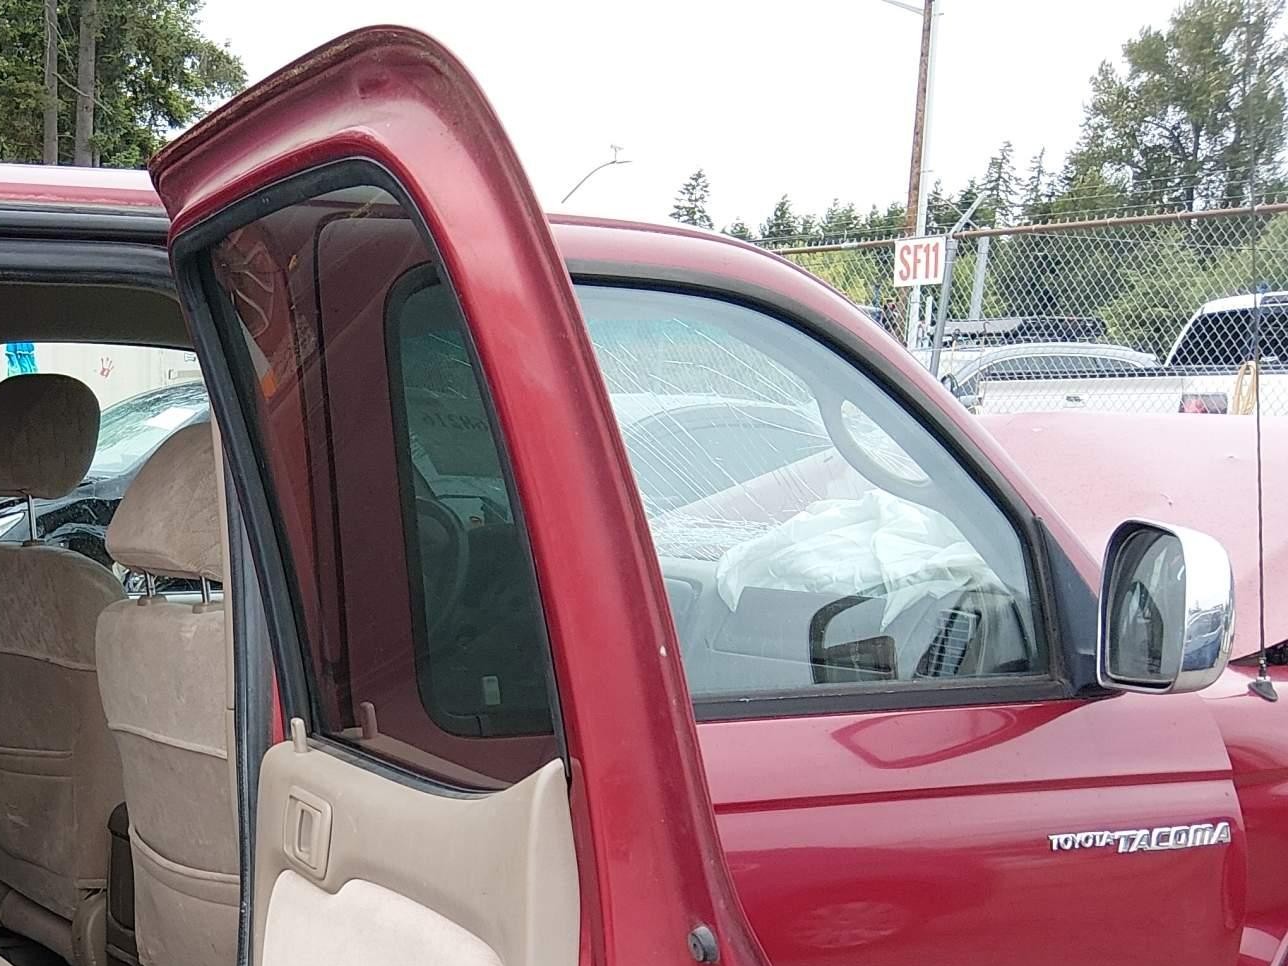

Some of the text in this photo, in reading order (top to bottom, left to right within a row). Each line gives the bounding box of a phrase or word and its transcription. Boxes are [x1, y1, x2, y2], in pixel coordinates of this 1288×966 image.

[899, 242, 940, 281] SF11
[1049, 822, 1232, 852] TOYOTA TACOMA
